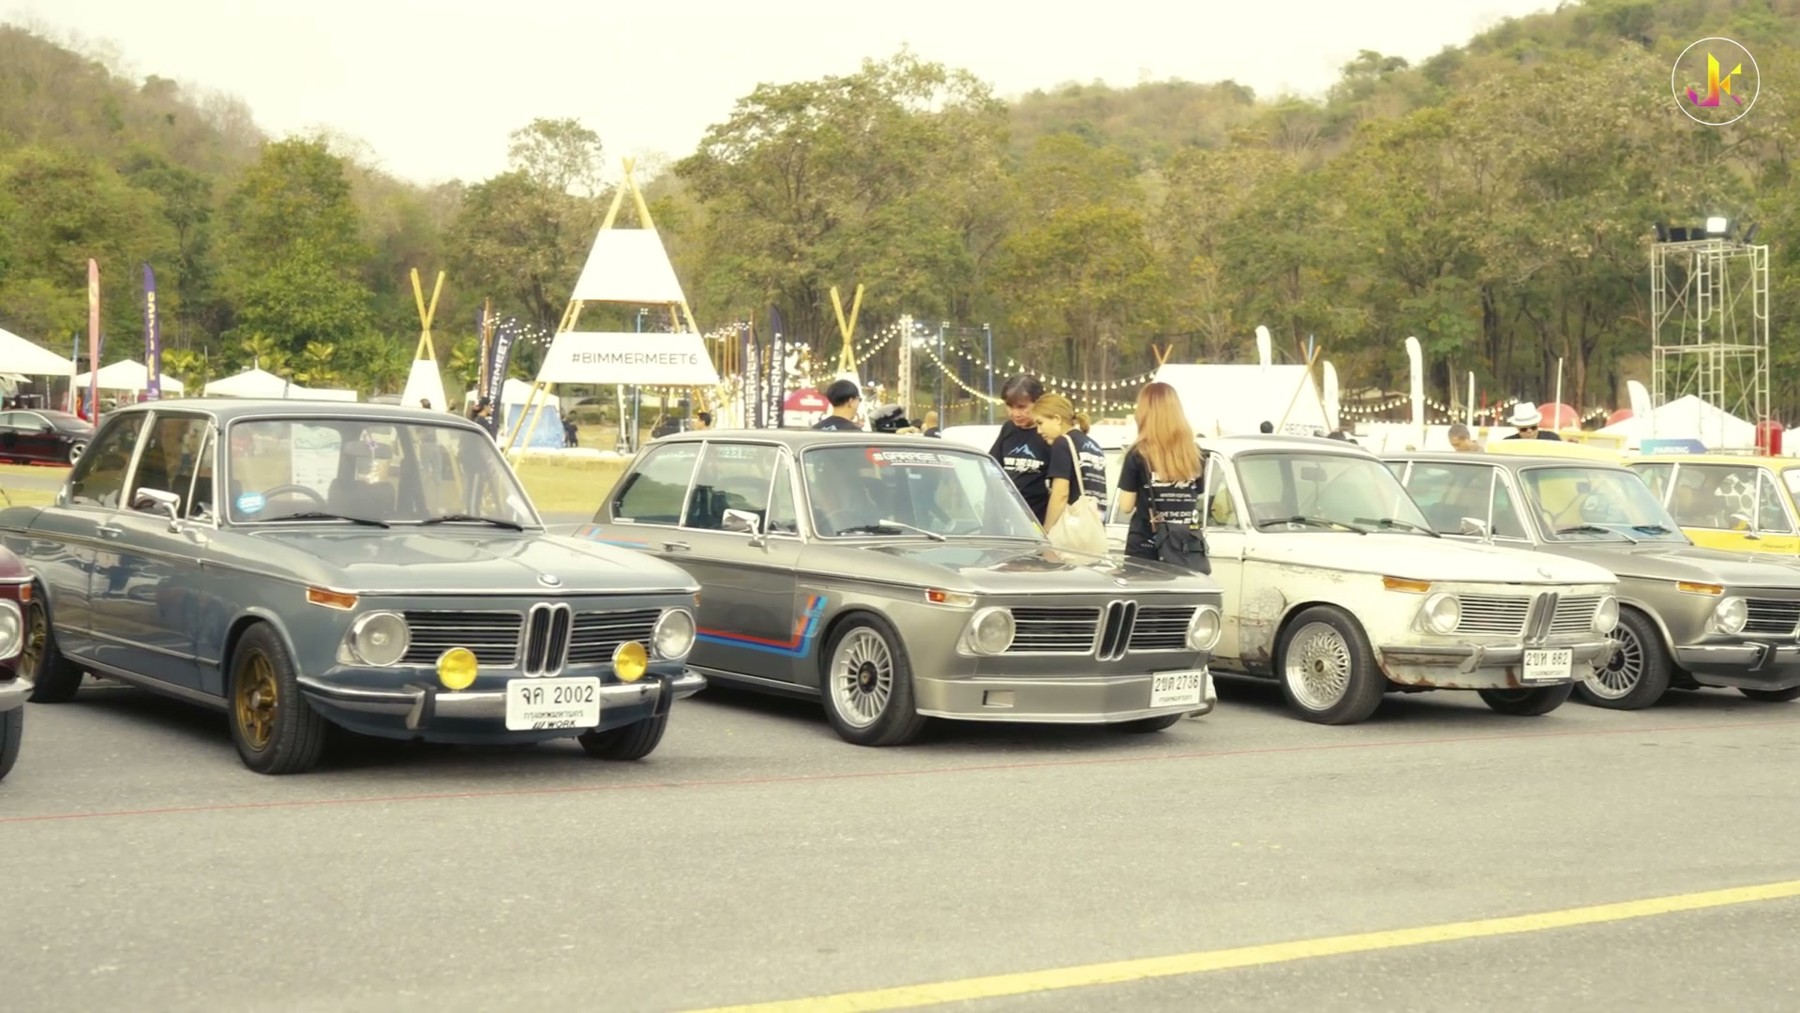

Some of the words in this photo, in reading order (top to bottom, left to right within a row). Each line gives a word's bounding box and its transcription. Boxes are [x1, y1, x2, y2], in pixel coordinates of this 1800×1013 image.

[572, 352, 698, 365] #BIMMERMEET6
[767, 333, 782, 429] IMMERMEET
[554, 685, 594, 704] 2002
